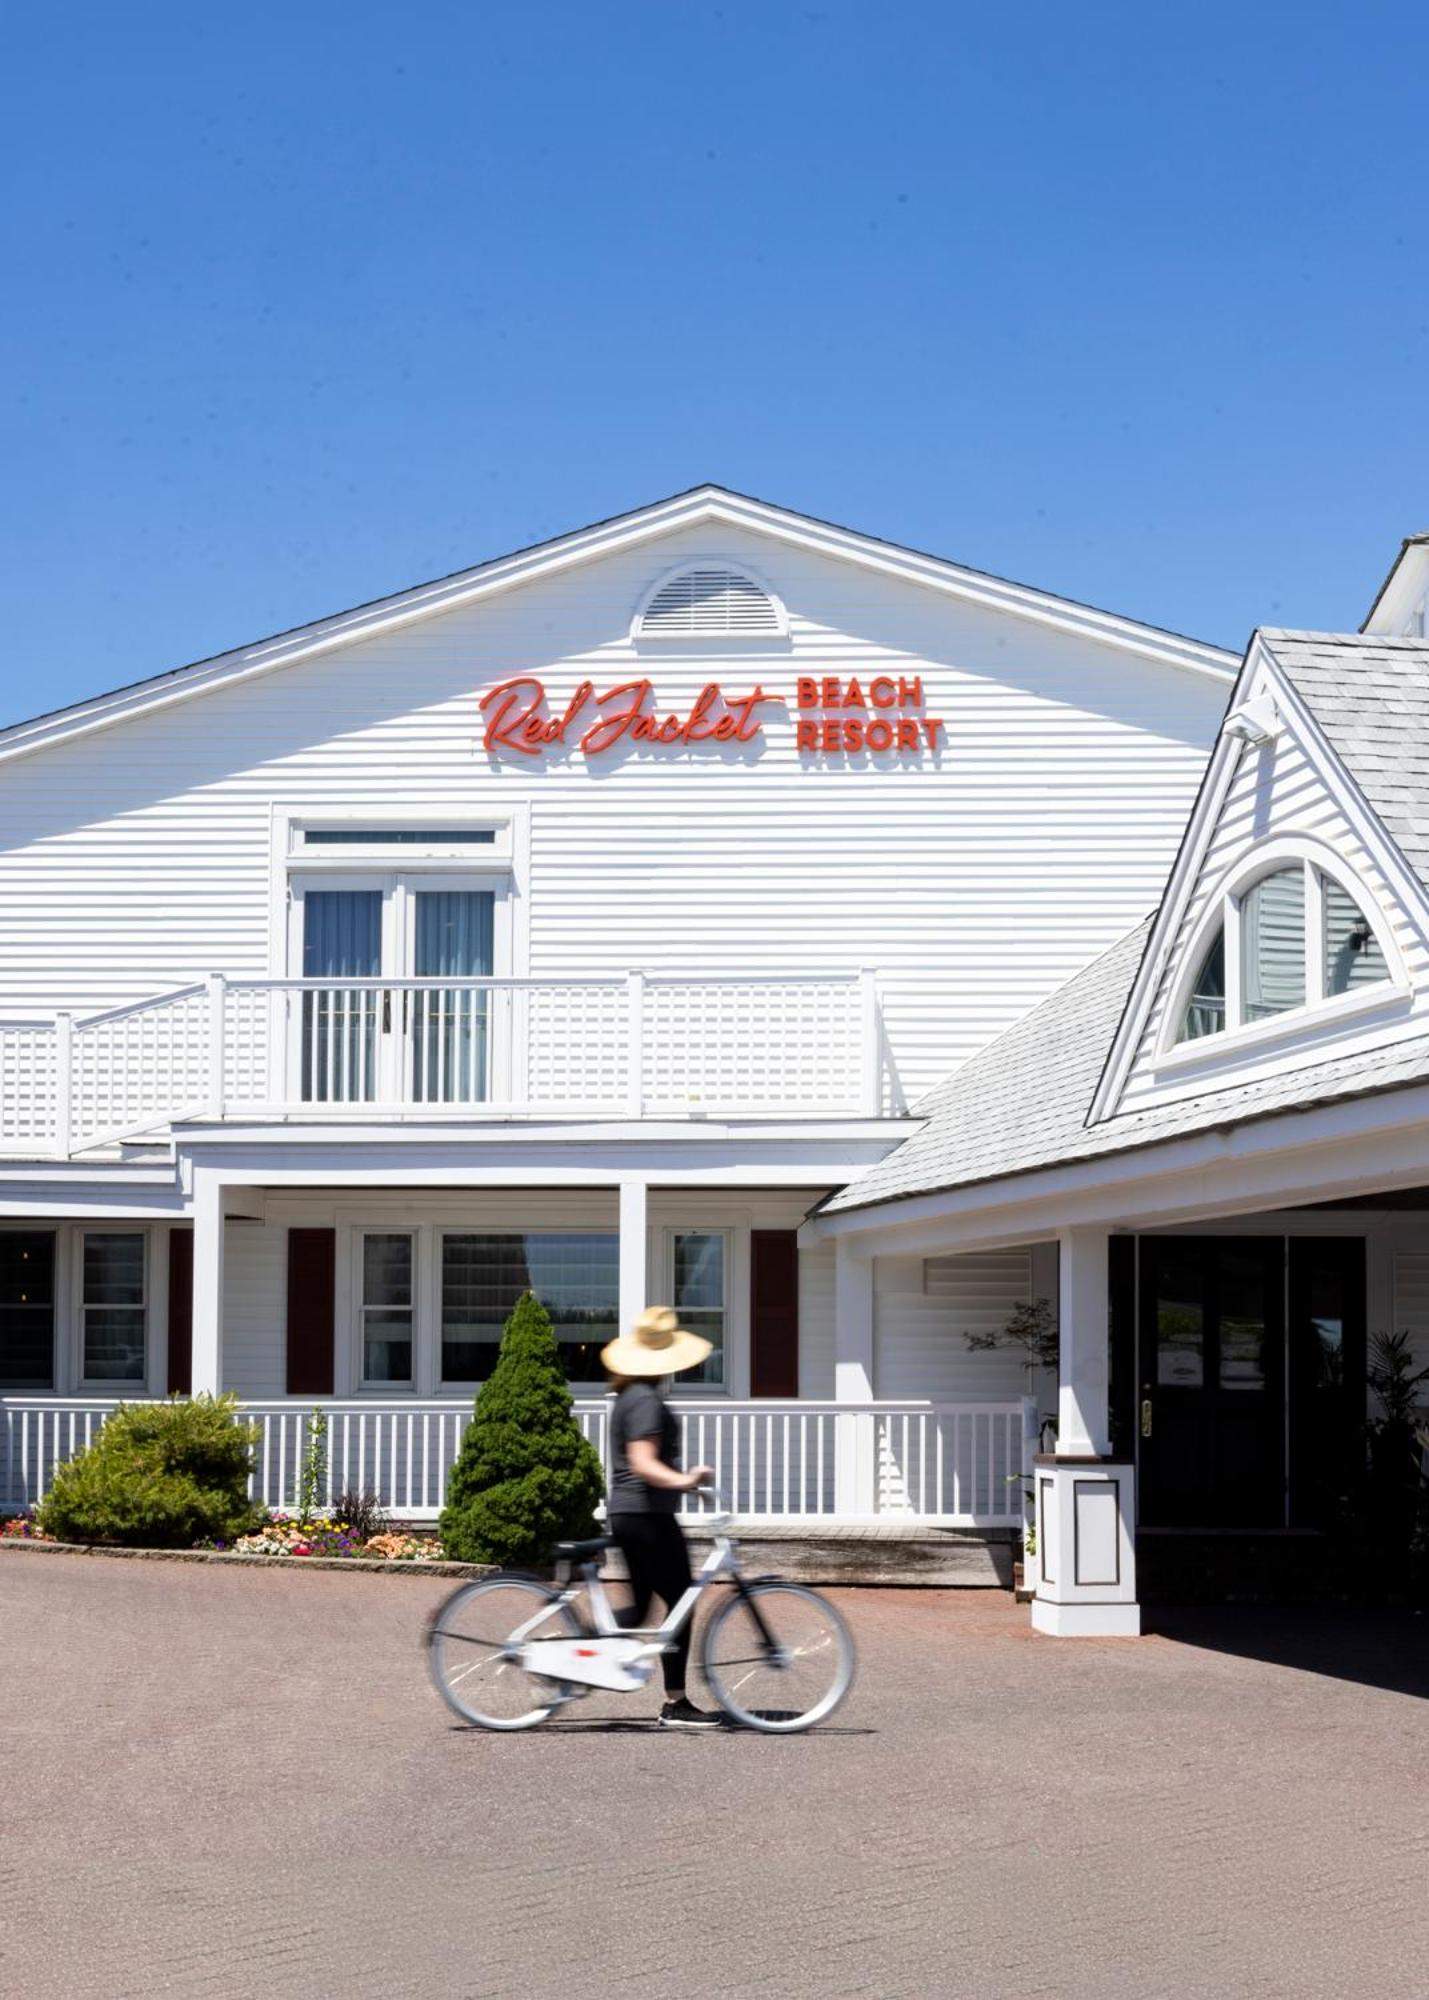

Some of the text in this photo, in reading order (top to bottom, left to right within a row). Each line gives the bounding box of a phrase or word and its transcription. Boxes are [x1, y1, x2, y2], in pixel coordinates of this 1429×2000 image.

[796, 676, 922, 709] BEACH
[479, 678, 785, 755] Red Jacket
[796, 718, 944, 752] RESORT
